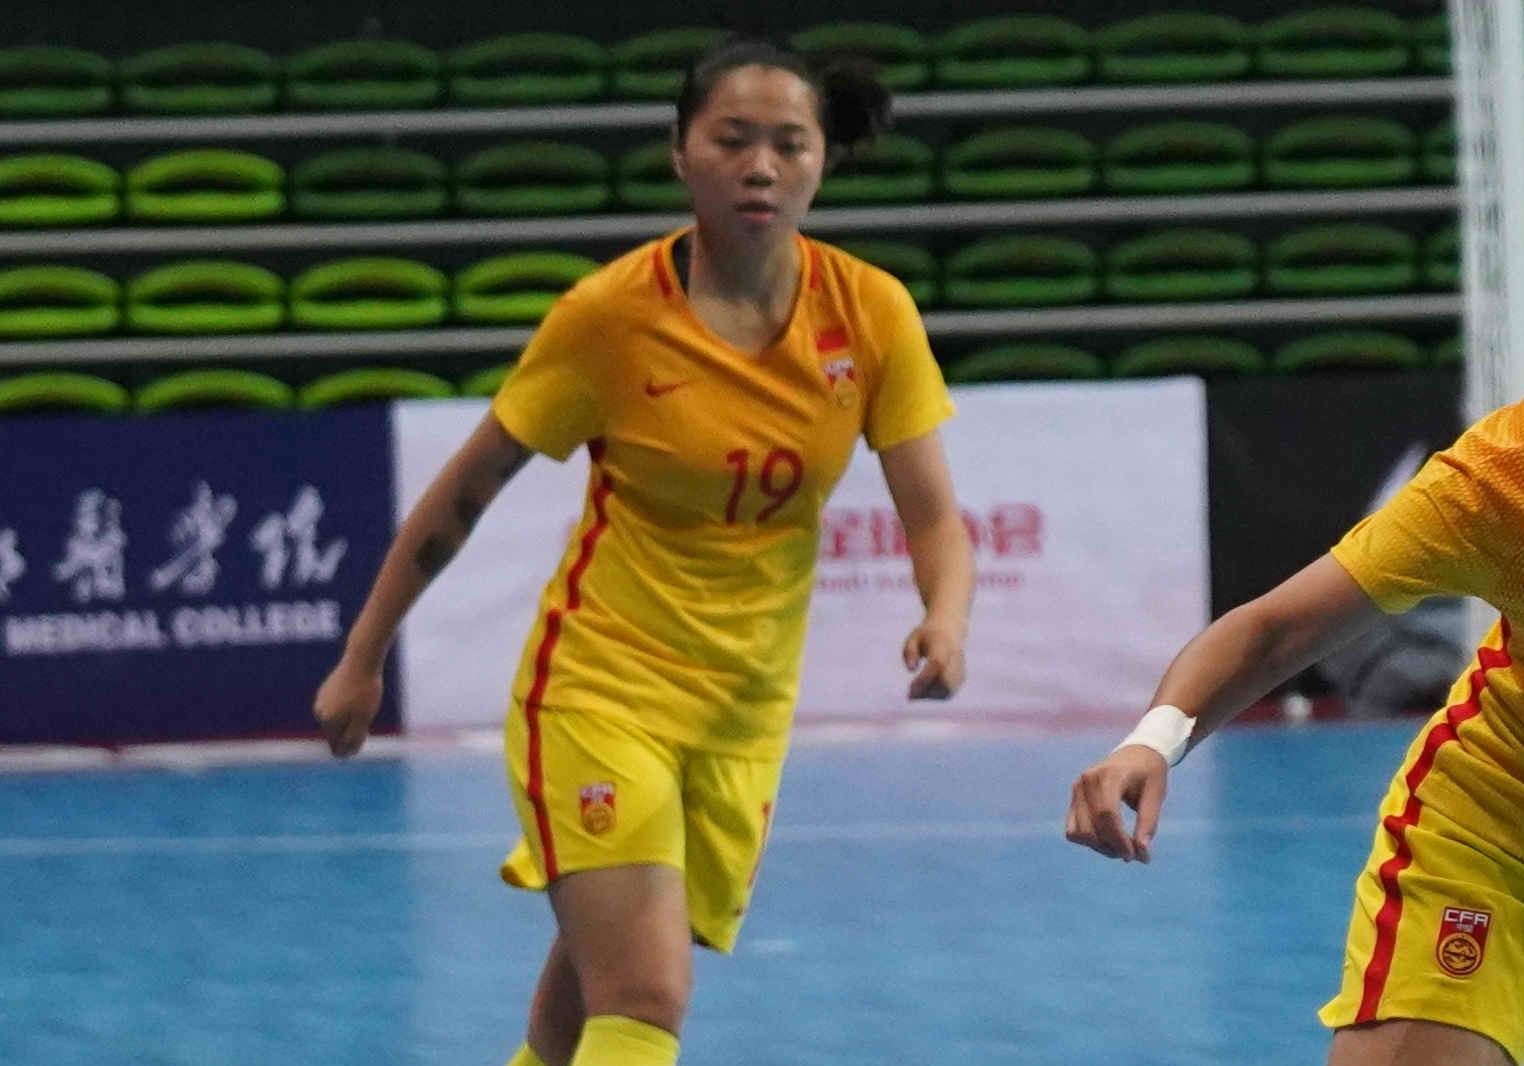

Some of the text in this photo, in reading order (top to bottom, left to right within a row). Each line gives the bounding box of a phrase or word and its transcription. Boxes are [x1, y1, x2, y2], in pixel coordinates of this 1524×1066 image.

[726, 448, 803, 526] 19
[5, 600, 341, 655] MEDICAL COLLEGE
[1444, 908, 1489, 928] CFA
